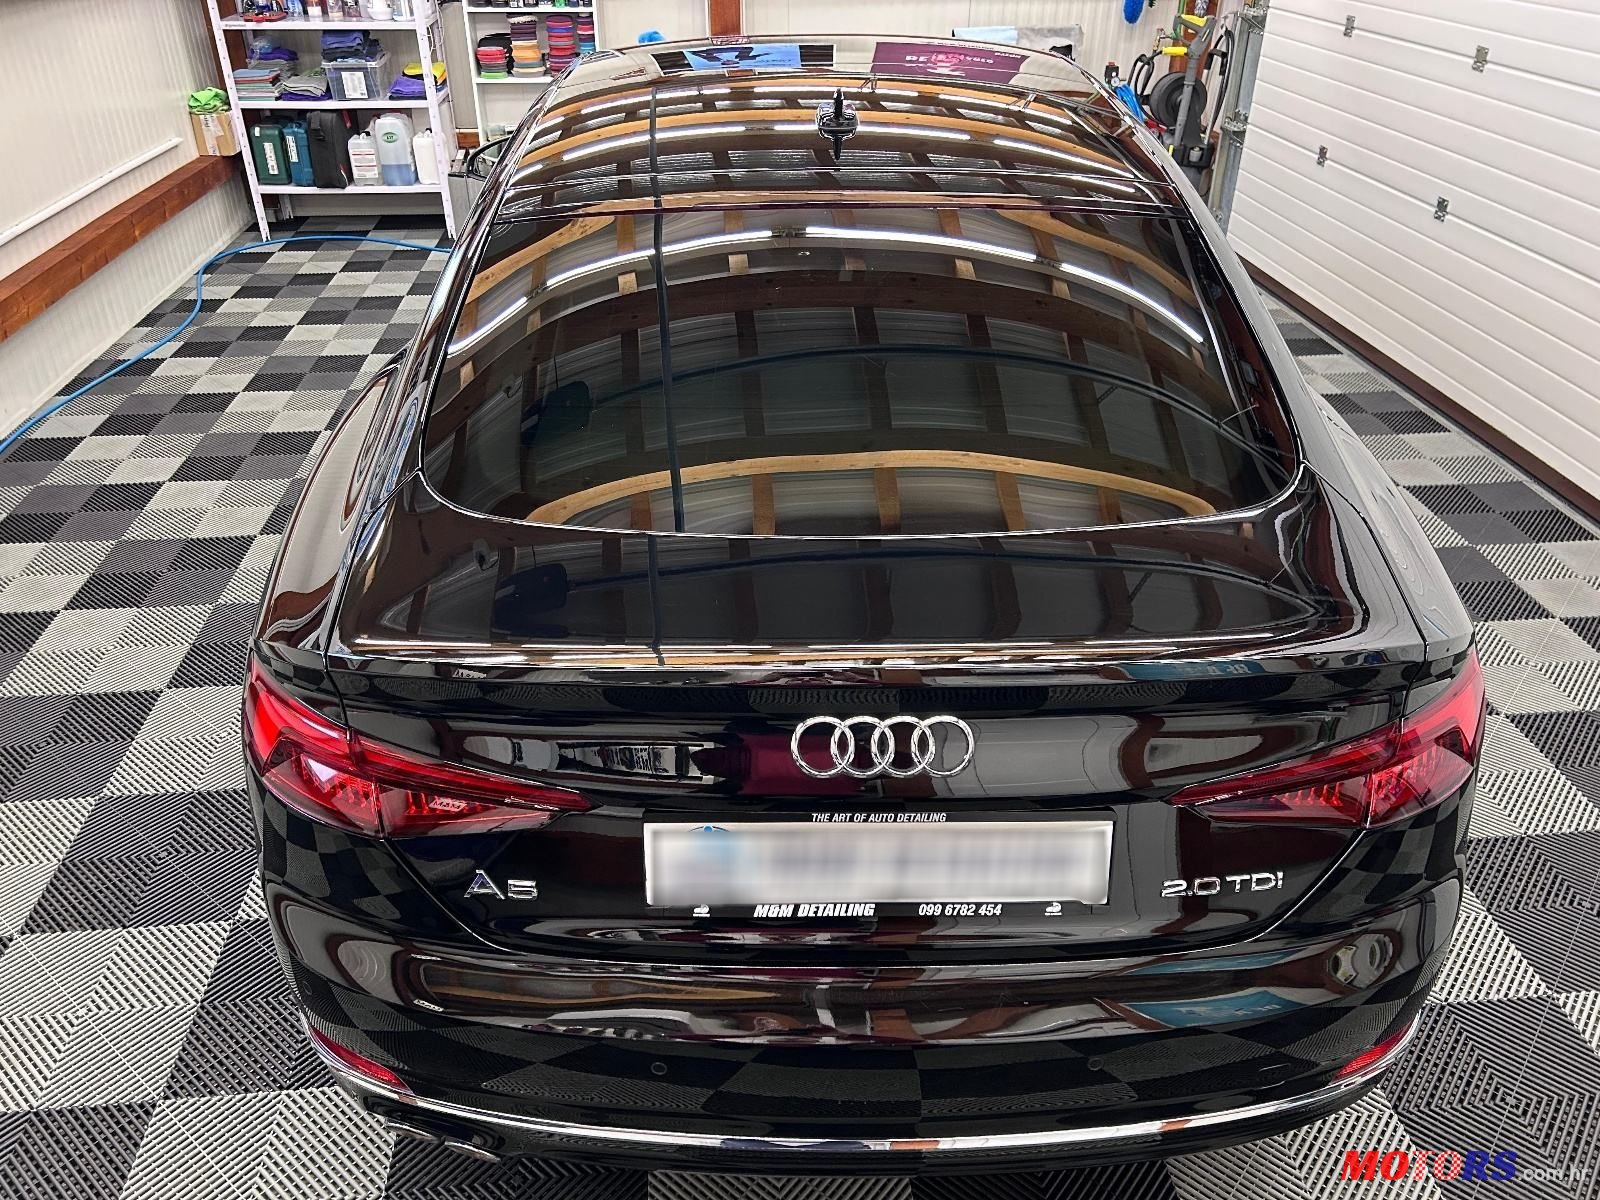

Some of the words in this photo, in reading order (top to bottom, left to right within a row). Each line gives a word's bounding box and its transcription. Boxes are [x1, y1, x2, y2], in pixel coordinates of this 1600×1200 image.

[811, 813, 830, 822] THE
[832, 813, 852, 822] ART
[853, 813, 867, 822] OF
[868, 813, 894, 822] AUTO
[896, 812, 946, 822] DETAILING
[463, 869, 538, 900] A5
[1161, 878, 1221, 897] 2.0
[1225, 871, 1284, 892] TDI
[753, 904, 795, 917] M&M
[797, 903, 875, 917] DETAILING
[918, 904, 942, 916] 099
[944, 904, 976, 916] 6782
[977, 904, 1002, 916] 454
